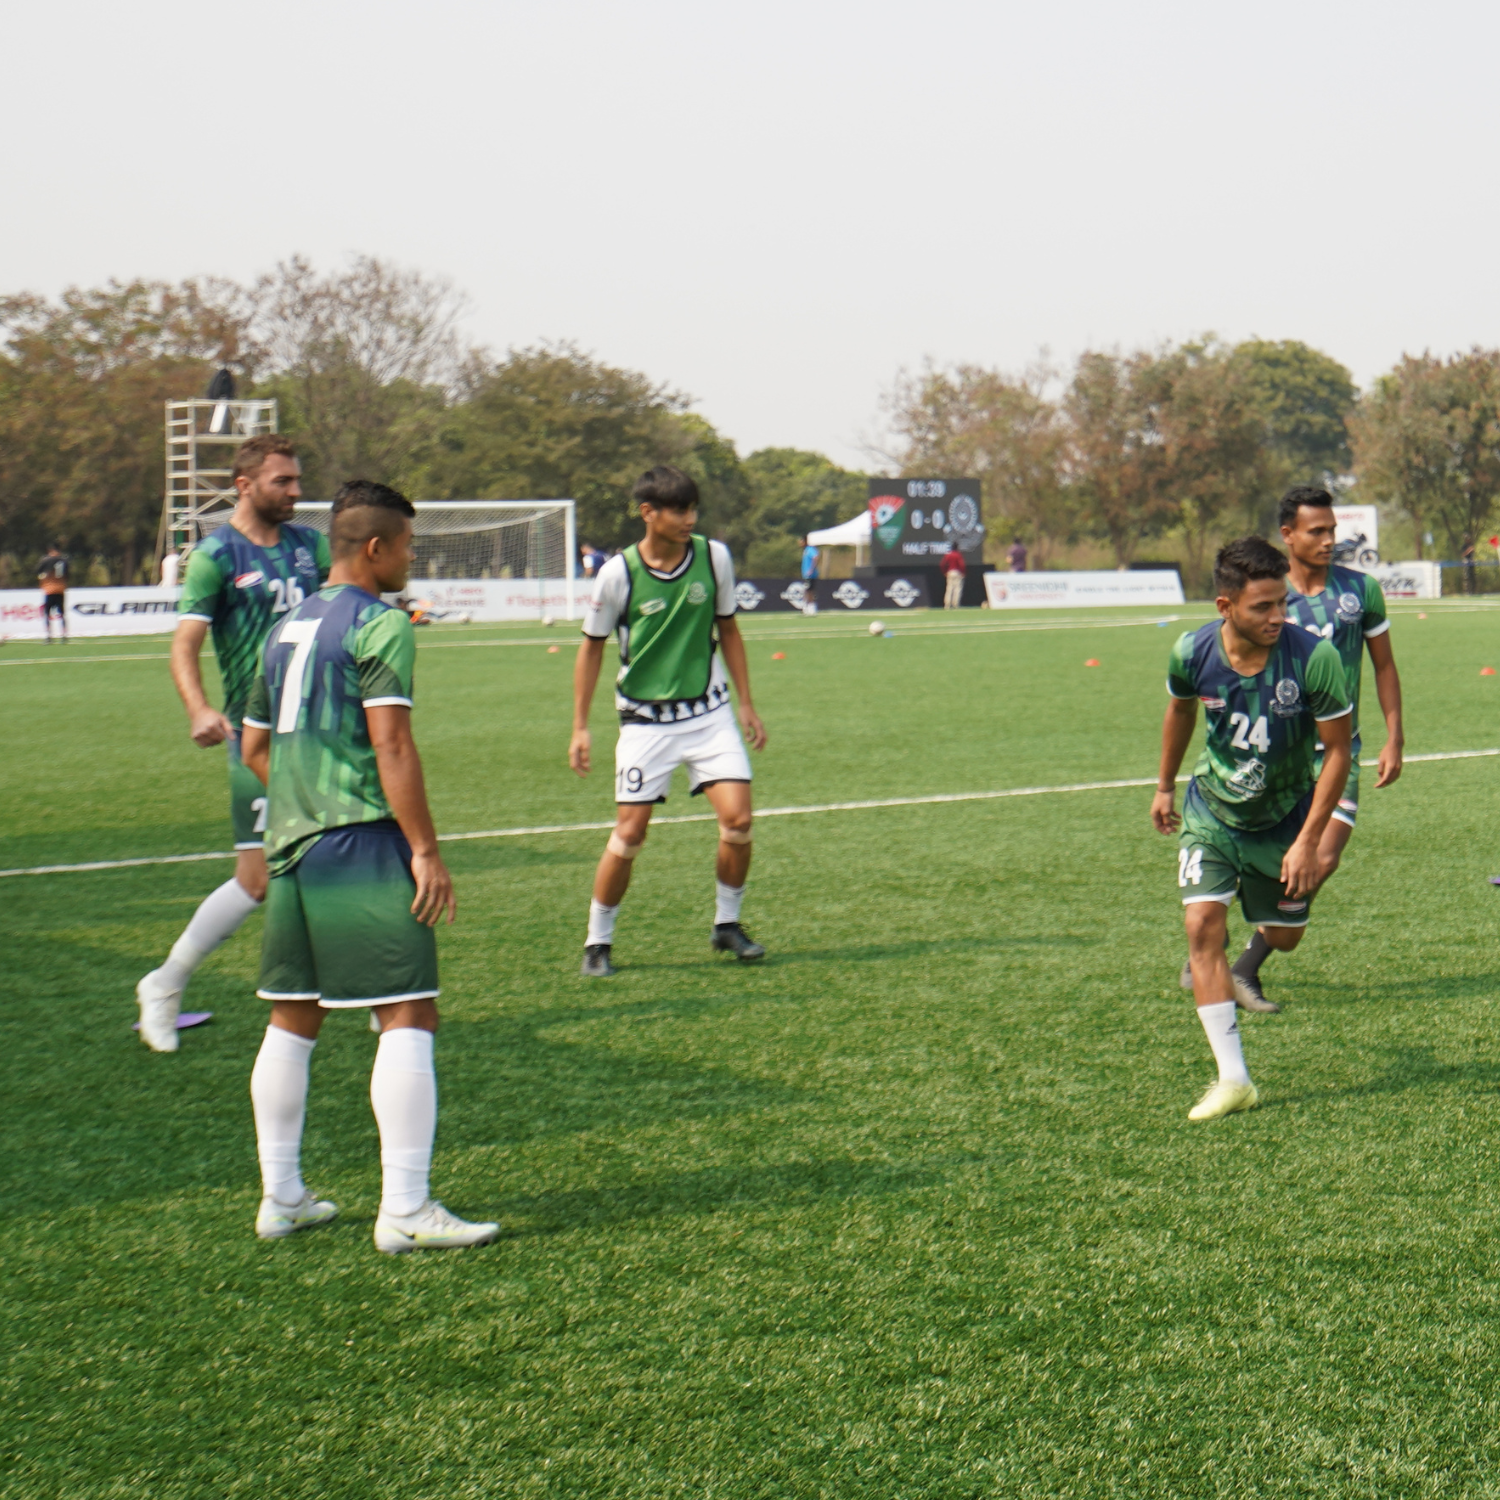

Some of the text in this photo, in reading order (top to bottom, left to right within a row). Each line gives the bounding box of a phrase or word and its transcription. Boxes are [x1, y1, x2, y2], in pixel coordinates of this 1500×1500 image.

[902, 541, 953, 555] HALF TIME
[268, 577, 305, 613] 26
[276, 618, 323, 734] 7
[1230, 712, 1271, 753] 24
[617, 767, 643, 793] 19
[1178, 848, 1203, 887] 24
